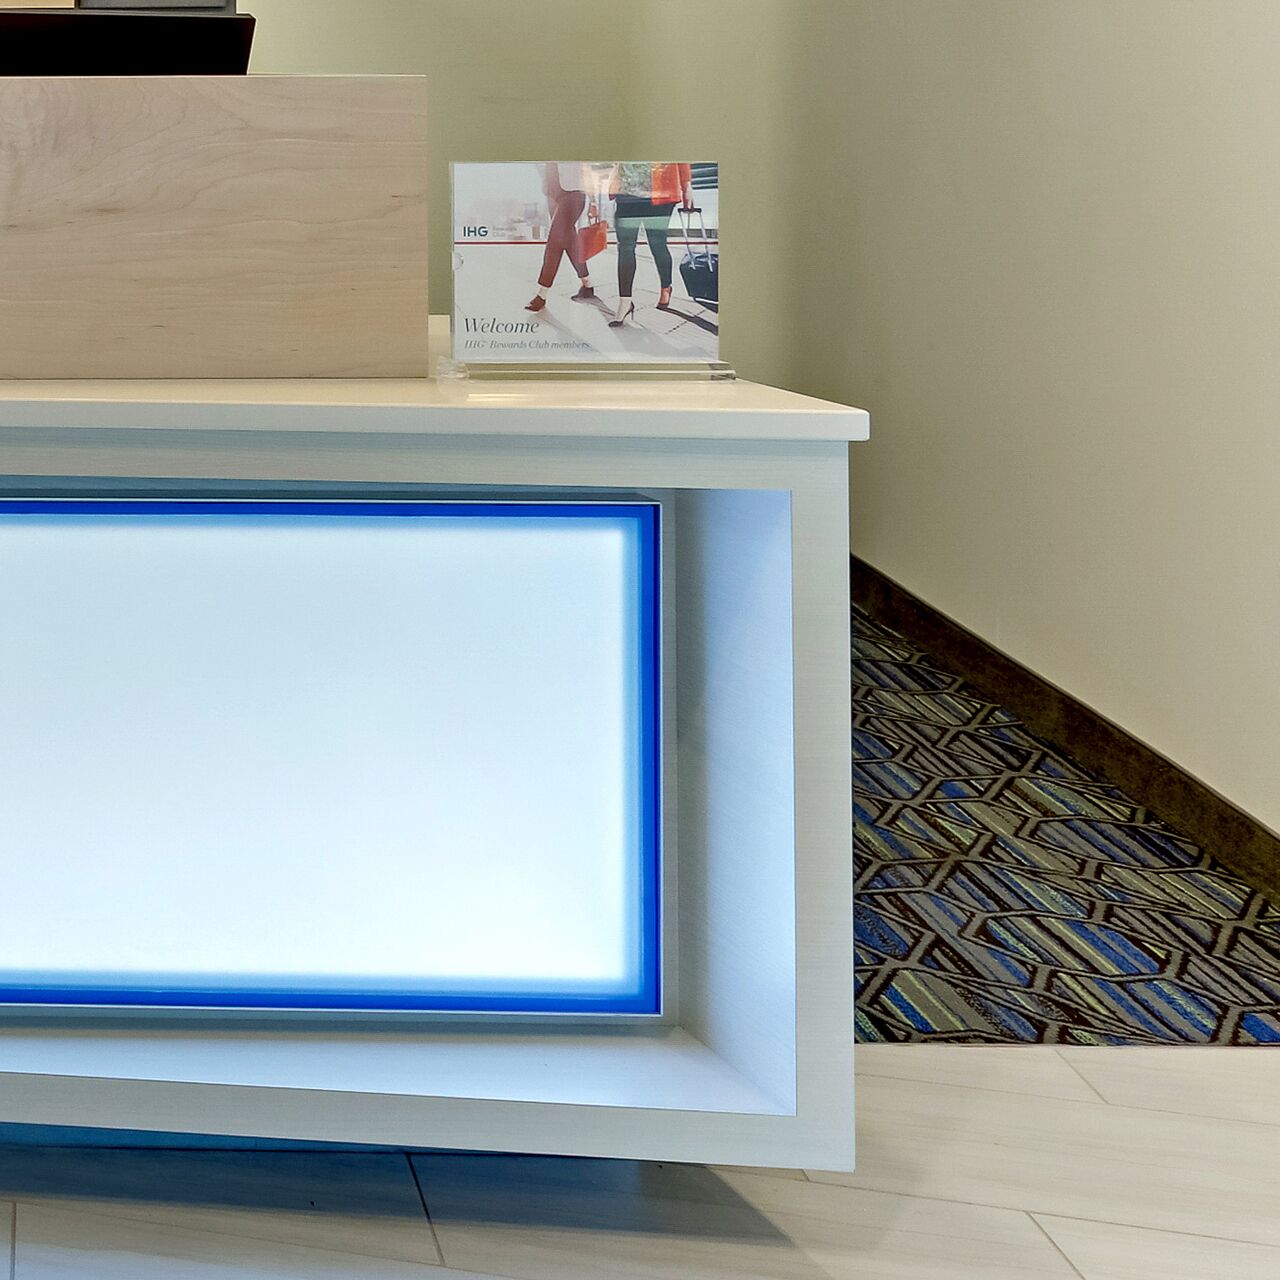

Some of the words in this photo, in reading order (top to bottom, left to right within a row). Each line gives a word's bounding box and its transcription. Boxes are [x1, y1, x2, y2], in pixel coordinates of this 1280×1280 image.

[463, 226, 489, 237] IHG
[464, 317, 540, 334] Welcome
[489, 339, 528, 349] Rewards
[528, 338, 550, 349] Club
